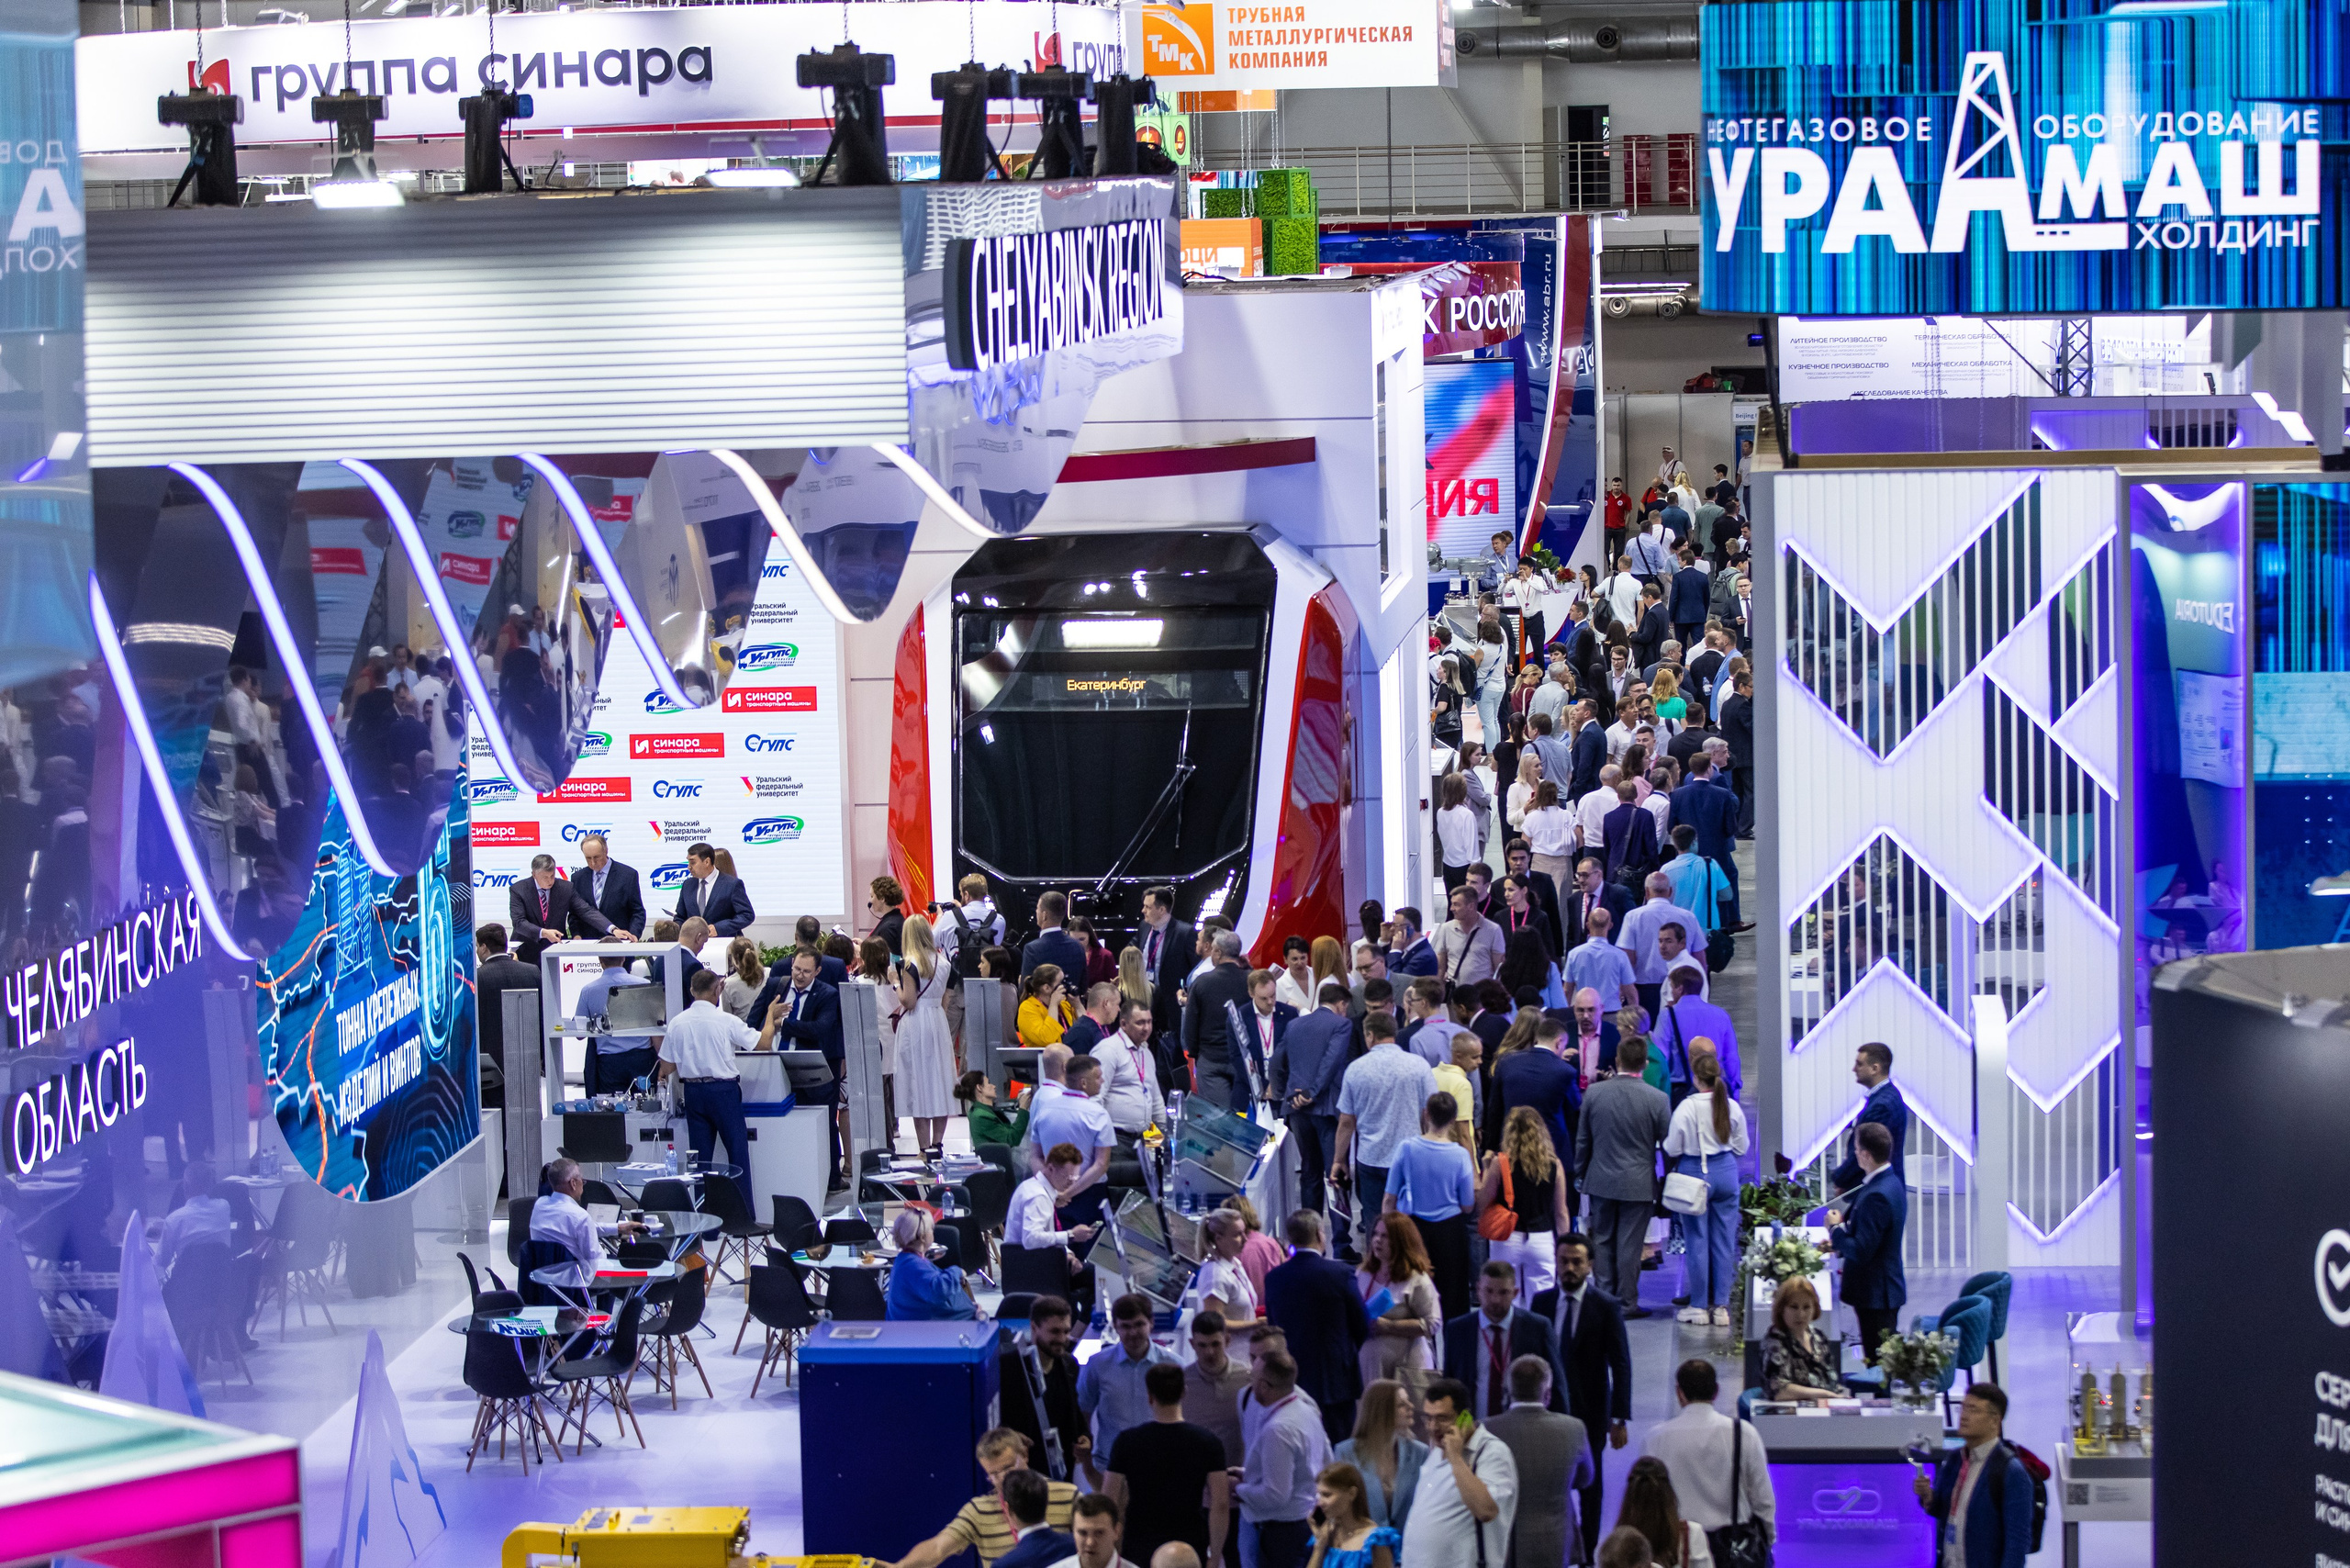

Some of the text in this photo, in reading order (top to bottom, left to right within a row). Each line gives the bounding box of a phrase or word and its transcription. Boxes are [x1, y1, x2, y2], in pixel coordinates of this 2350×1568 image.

[1226, 6, 1306, 24] ТРУБНАЯ
[1227, 25, 1414, 47] МЕТАЛЛУРГИЧЕСКАЯ
[1147, 34, 1195, 71] ТМК
[1228, 50, 1328, 70] КОМПАНИЯ
[251, 44, 714, 114] группа синара
[1706, 109, 2321, 143] НЕФТЕГАЗОВОЕ ОБОРУДОВАНИЕ
[2134, 218, 2320, 255] ХОЛДИНГ
[970, 218, 1167, 374] CHELYABINSK REGION
[1450, 289, 1527, 333] РОССИЯ
[1789, 335, 1888, 344] ЛИТЕЙНОЕ ПРОИЗВОДСТВО
[1788, 362, 1890, 371] КУЗНЕЧНОЕ ПРОИЗВОДСТВО
[1066, 678, 1147, 693] Екатеринбург
[745, 690, 792, 702] синара
[653, 737, 700, 748] синара
[744, 734, 795, 752] СГУПС
[560, 781, 607, 792] синара
[653, 779, 703, 798] СГУПС
[472, 826, 516, 837] синара
[664, 834, 707, 843] университет
[4, 889, 203, 1051] ЧЕЛЯБИНСКАЯ
[336, 967, 420, 1058] ТОННА КРЕПЕЖНЫХ
[339, 1034, 421, 1127] ИЗДЕЛИЙ И ВИНТОВ
[13, 1036, 148, 1176] ОБЛАСТЬ
